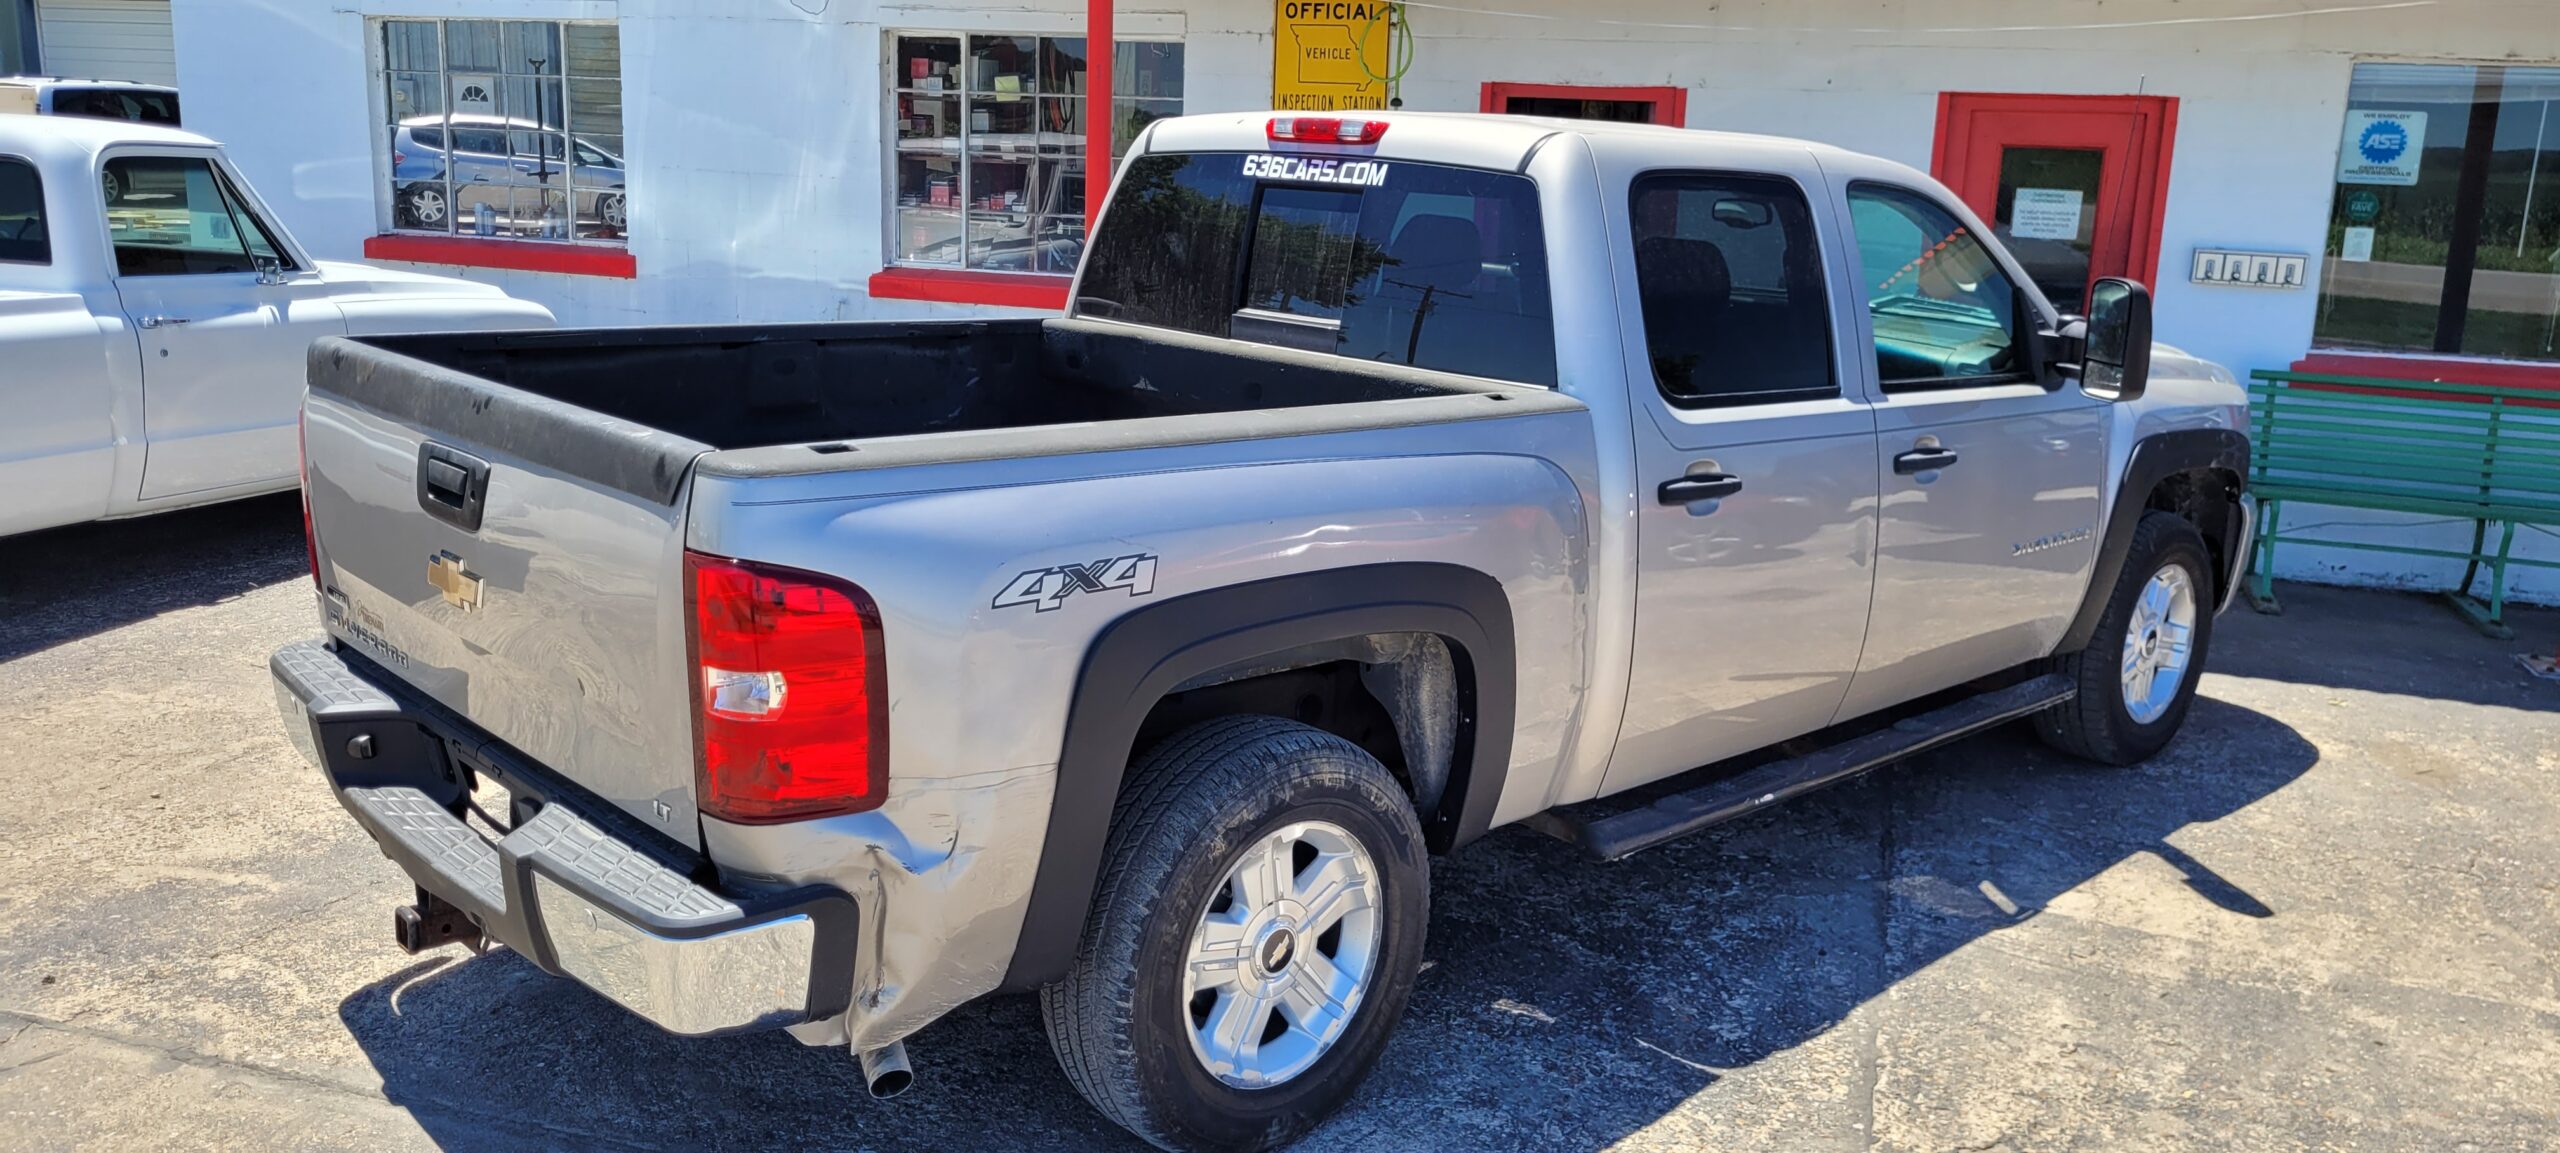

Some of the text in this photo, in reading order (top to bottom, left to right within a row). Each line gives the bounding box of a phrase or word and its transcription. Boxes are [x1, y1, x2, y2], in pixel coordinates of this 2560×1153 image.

[1285, 2, 1381, 21] OFFICIAL
[1305, 47, 1351, 60] VEHICLE
[1278, 93, 1382, 111] INSPECTION STATION
[2364, 133, 2401, 149] ASE
[1242, 155, 1388, 186] 636CARS.COM
[653, 799, 673, 823] LT
